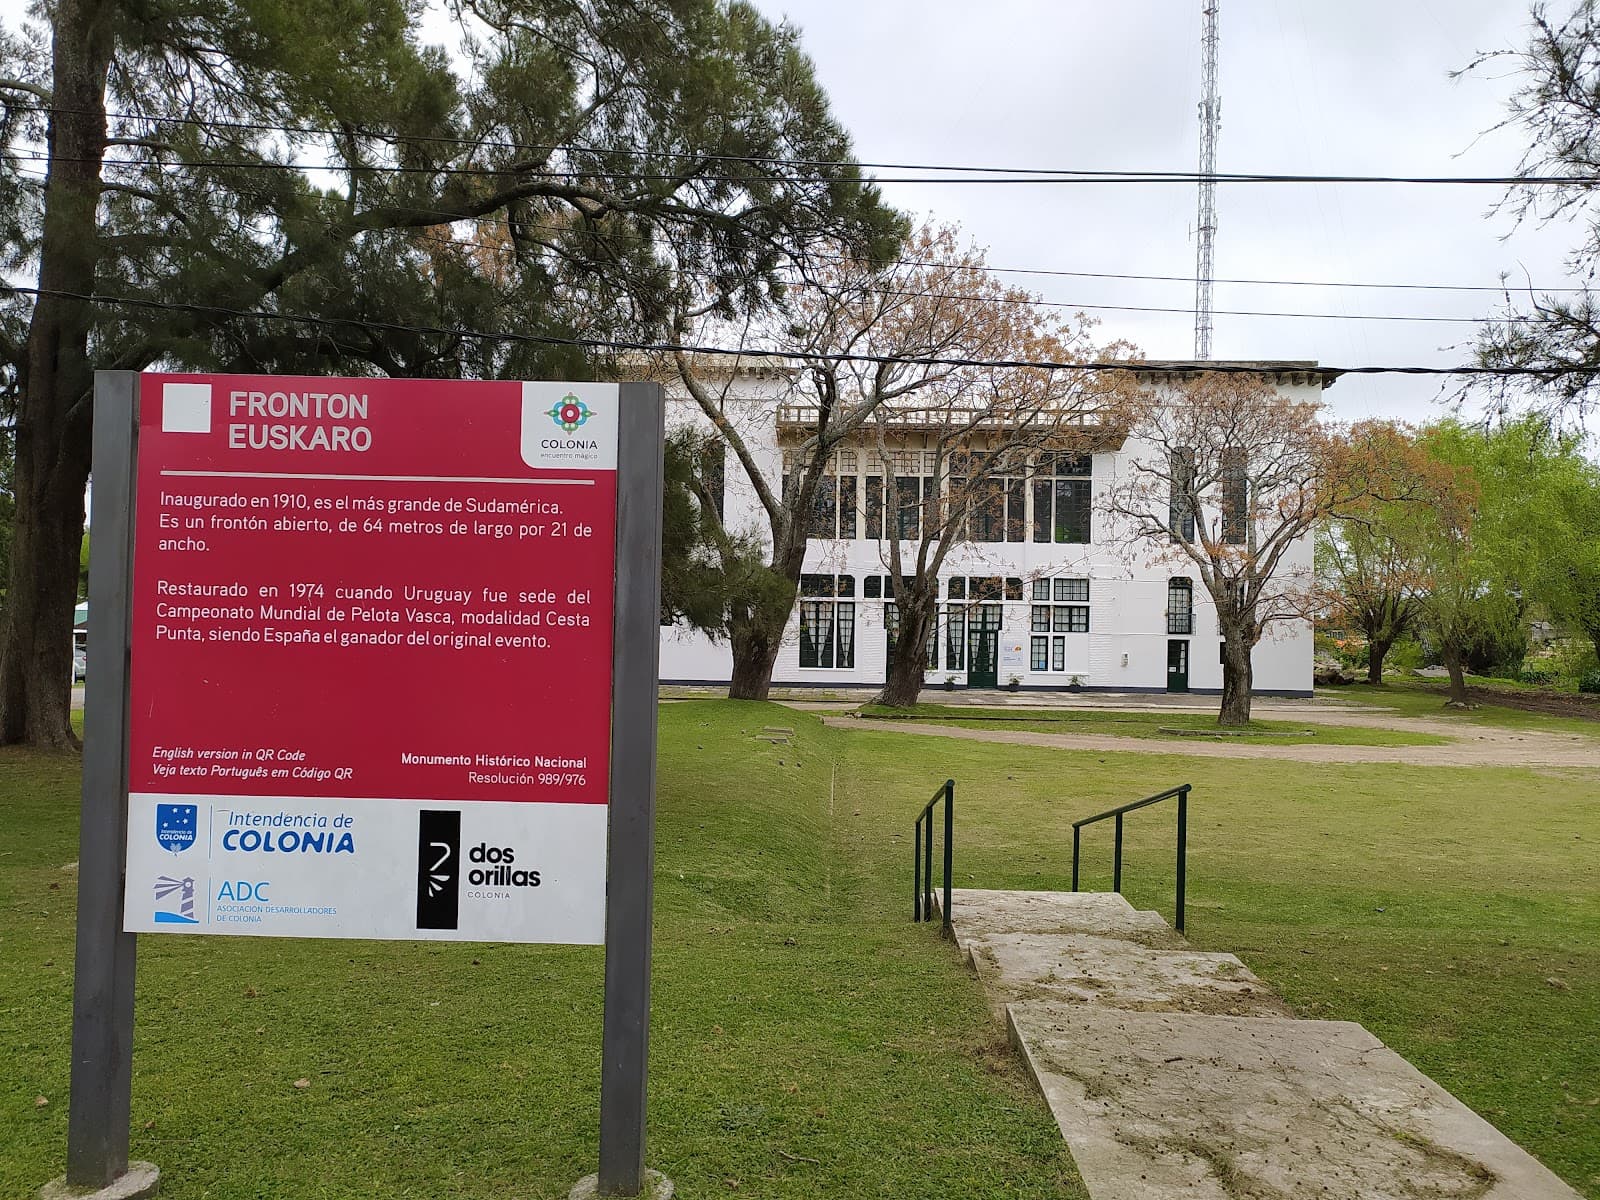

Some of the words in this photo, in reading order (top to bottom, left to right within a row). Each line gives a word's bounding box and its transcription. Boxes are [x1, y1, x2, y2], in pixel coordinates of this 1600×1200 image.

[229, 390, 369, 420] FRONTON
[228, 423, 372, 452] EUSKARO
[541, 439, 598, 450] COLONIA
[541, 452, 573, 460] encuentro
[160, 491, 248, 510] Inaugurado
[250, 496, 270, 508] en
[272, 493, 311, 511] 1910,
[313, 498, 333, 510] es
[335, 495, 349, 510] el
[352, 495, 385, 511] más
[387, 497, 441, 514] grande
[444, 497, 463, 513] de
[465, 497, 563, 515] Sudamérica.
[159, 513, 179, 529] Es
[185, 517, 205, 529] un
[210, 514, 268, 530] frontón
[273, 515, 333, 534] abierto,
[338, 517, 358, 533] de
[362, 517, 383, 533] 64
[388, 520, 444, 534] metros
[449, 519, 468, 535] de
[474, 519, 513, 539] largo
[519, 524, 546, 540] por
[550, 521, 567, 537] 21
[573, 522, 592, 538] de
[158, 536, 210, 552] ancho.
[157, 580, 248, 597] Restaurado
[258, 586, 278, 598] en
[289, 583, 325, 599] 1974
[335, 584, 393, 600] cuando
[404, 585, 472, 606] Uruguay
[482, 587, 508, 603] fue
[518, 588, 556, 604] sede
[566, 589, 591, 605] del
[156, 602, 254, 622] Campeonato
[260, 604, 321, 621] Mundial
[326, 606, 346, 622] de
[351, 606, 400, 623] Pelota
[405, 607, 455, 626] Vasca,
[461, 609, 541, 626] modalidad
[545, 610, 590, 627] Cesta
[156, 624, 205, 643] Punta,
[208, 626, 261, 642] siendo
[263, 627, 321, 647] España
[323, 628, 337, 644] el
[340, 629, 404, 647] ganador
[406, 630, 430, 646] del
[432, 631, 492, 650] original
[494, 634, 551, 648] evento.
[152, 746, 194, 763] English
[197, 747, 239, 760] version
[241, 748, 253, 760] in
[255, 748, 275, 762] QR
[277, 749, 306, 761] Code
[401, 752, 472, 766] Monumento
[475, 754, 531, 767] Histórico
[534, 755, 587, 769] Nacional
[153, 763, 177, 778] Veja
[179, 765, 208, 776] texto
[210, 764, 269, 780] Português
[271, 769, 289, 778] em
[292, 766, 332, 782] Código
[334, 767, 353, 781] QR
[468, 771, 534, 785] Resolución
[537, 772, 586, 786] 989/976
[228, 811, 328, 828] Intendencia
[333, 813, 354, 829] de
[222, 829, 355, 854] COLONIA
[468, 842, 515, 864] dos
[468, 865, 541, 887] orillas
[217, 880, 270, 902] ADC
[467, 891, 511, 899] COLONIA
[228, 915, 262, 923] COLONIA
[265, 906, 337, 915] DESARROLLADORES
